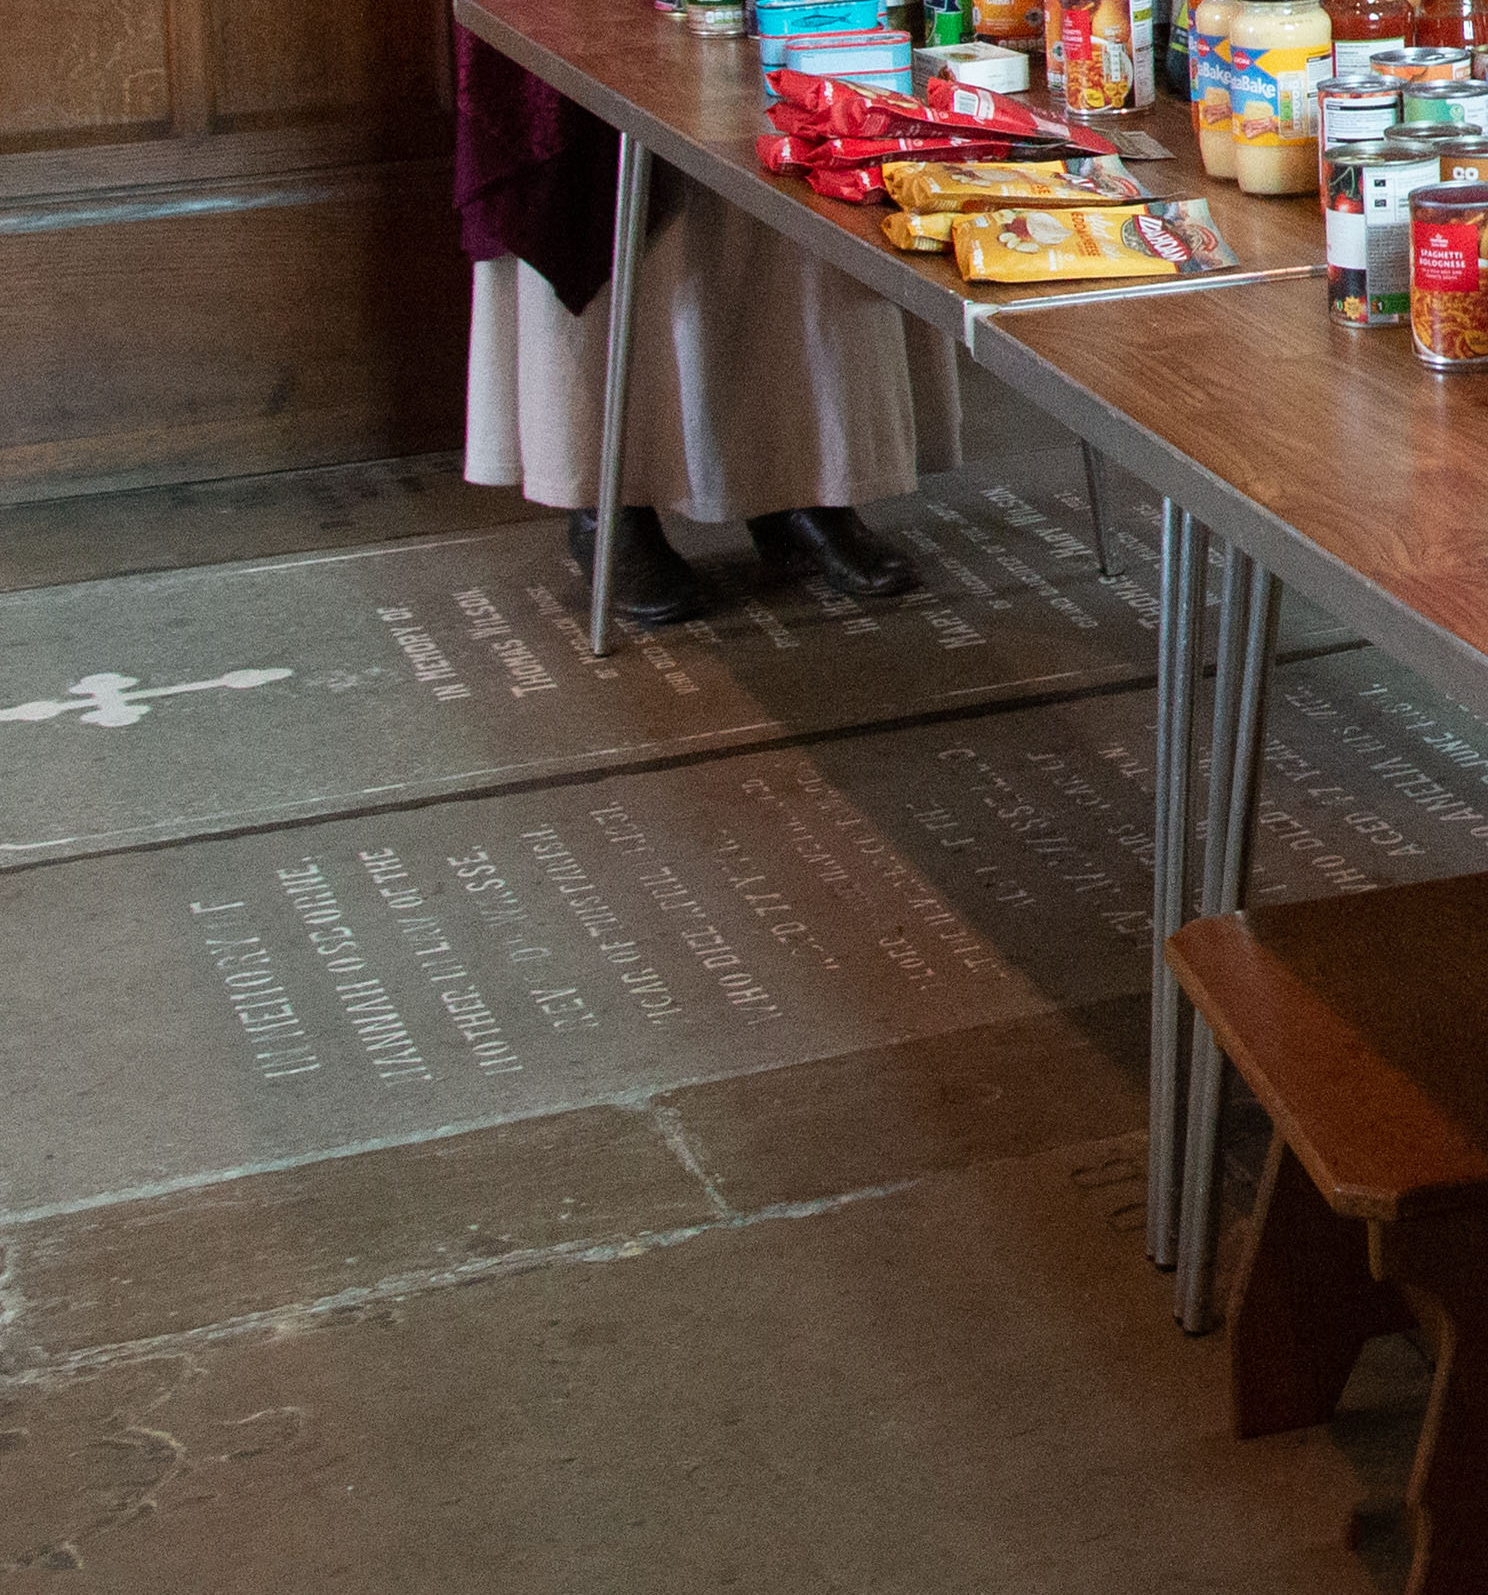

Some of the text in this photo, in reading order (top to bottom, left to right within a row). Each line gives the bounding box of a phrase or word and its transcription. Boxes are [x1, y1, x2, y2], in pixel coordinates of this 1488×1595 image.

[1137, 215, 1188, 263] IDAHOAN
[1419, 249, 1463, 261] SPAGHETTI
[1419, 258, 1466, 270] BOLOGNESE
[384, 623, 459, 681] MEMORY
[477, 638, 562, 697] THOMAS
[1363, 756, 1486, 824] AMELIA
[1251, 809, 1329, 851] DIED
[1336, 808, 1428, 859] AGED
[356, 845, 411, 884] THE
[378, 882, 427, 910] OF
[565, 893, 626, 936] THIS
[395, 912, 454, 955] LAW
[597, 938, 646, 964] OF
[678, 924, 742, 968] DIED
[712, 969, 785, 1025] WHO
[331, 976, 436, 1088] HANNAH
[437, 984, 527, 1076] MOTHER
